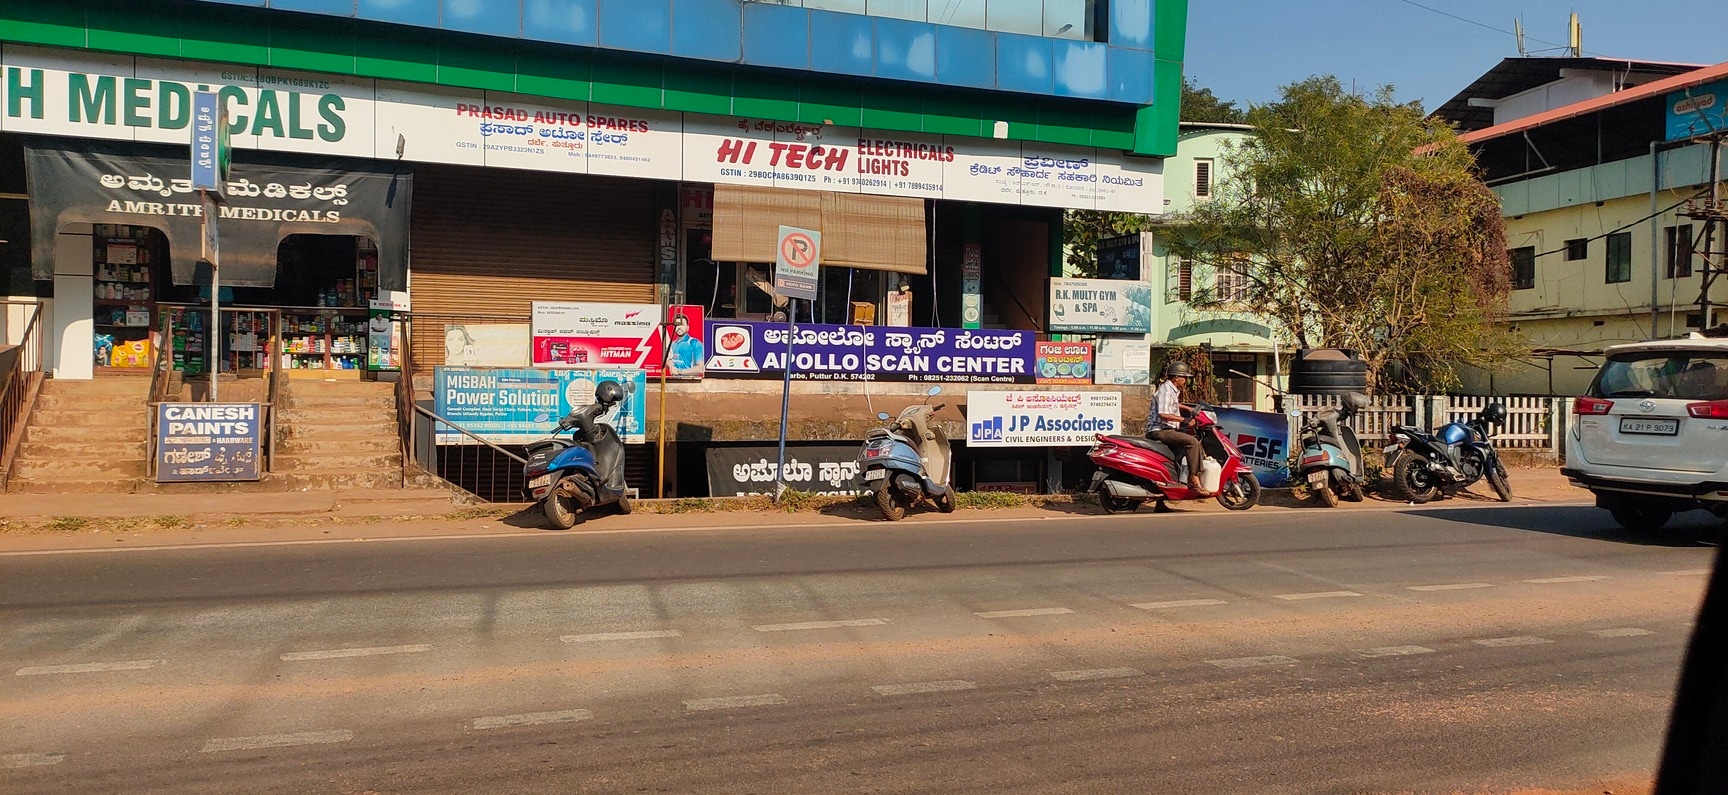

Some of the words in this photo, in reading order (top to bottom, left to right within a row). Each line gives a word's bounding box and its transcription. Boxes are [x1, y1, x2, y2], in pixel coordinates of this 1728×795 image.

[68, 72, 346, 142] MEDCALS
[456, 103, 528, 123] PRASAD
[533, 111, 581, 126] AUTO
[586, 116, 649, 132] SPARES
[480, 122, 534, 136] ಪ್ರಸಾದ್
[716, 139, 757, 164] HI
[768, 142, 849, 172] TECH
[857, 139, 954, 163] ELECTRICALS
[720, 168, 741, 176] GSTIN
[857, 156, 910, 177] LIGHTS
[970, 163, 1001, 176] ಕ್ರೆಡಿಟ್
[1058, 171, 1097, 182] ಸಹಕಾರಿ
[1102, 175, 1143, 187] ನಿಯಮಿತ
[227, 178, 349, 206] ಮೆಡಿಕಲ್ಸ್
[218, 206, 340, 223] MEDICALS
[1056, 290, 1070, 300] R.K.
[1072, 290, 1097, 300] MULTY
[1100, 290, 1116, 300] GYM
[1075, 304, 1080, 312] &
[1082, 303, 1097, 312] SPA
[885, 330, 945, 354] ಸ್ಕ್ಯಾನ್
[955, 331, 1022, 350] ಸೆಂಟರ್
[1065, 346, 1088, 354] ಊಟ
[866, 354, 929, 372] SCAN
[936, 356, 1024, 374] CENTER
[447, 375, 495, 389] MISBAH
[446, 389, 495, 405] Power
[499, 390, 559, 405] Solution
[165, 408, 254, 420] GANESH
[1034, 413, 1114, 432] Associates
[169, 422, 249, 434] PAINTS
[974, 428, 1002, 438] JPA
[1255, 438, 1282, 459] SF
[1240, 456, 1279, 469] ATTERIES
